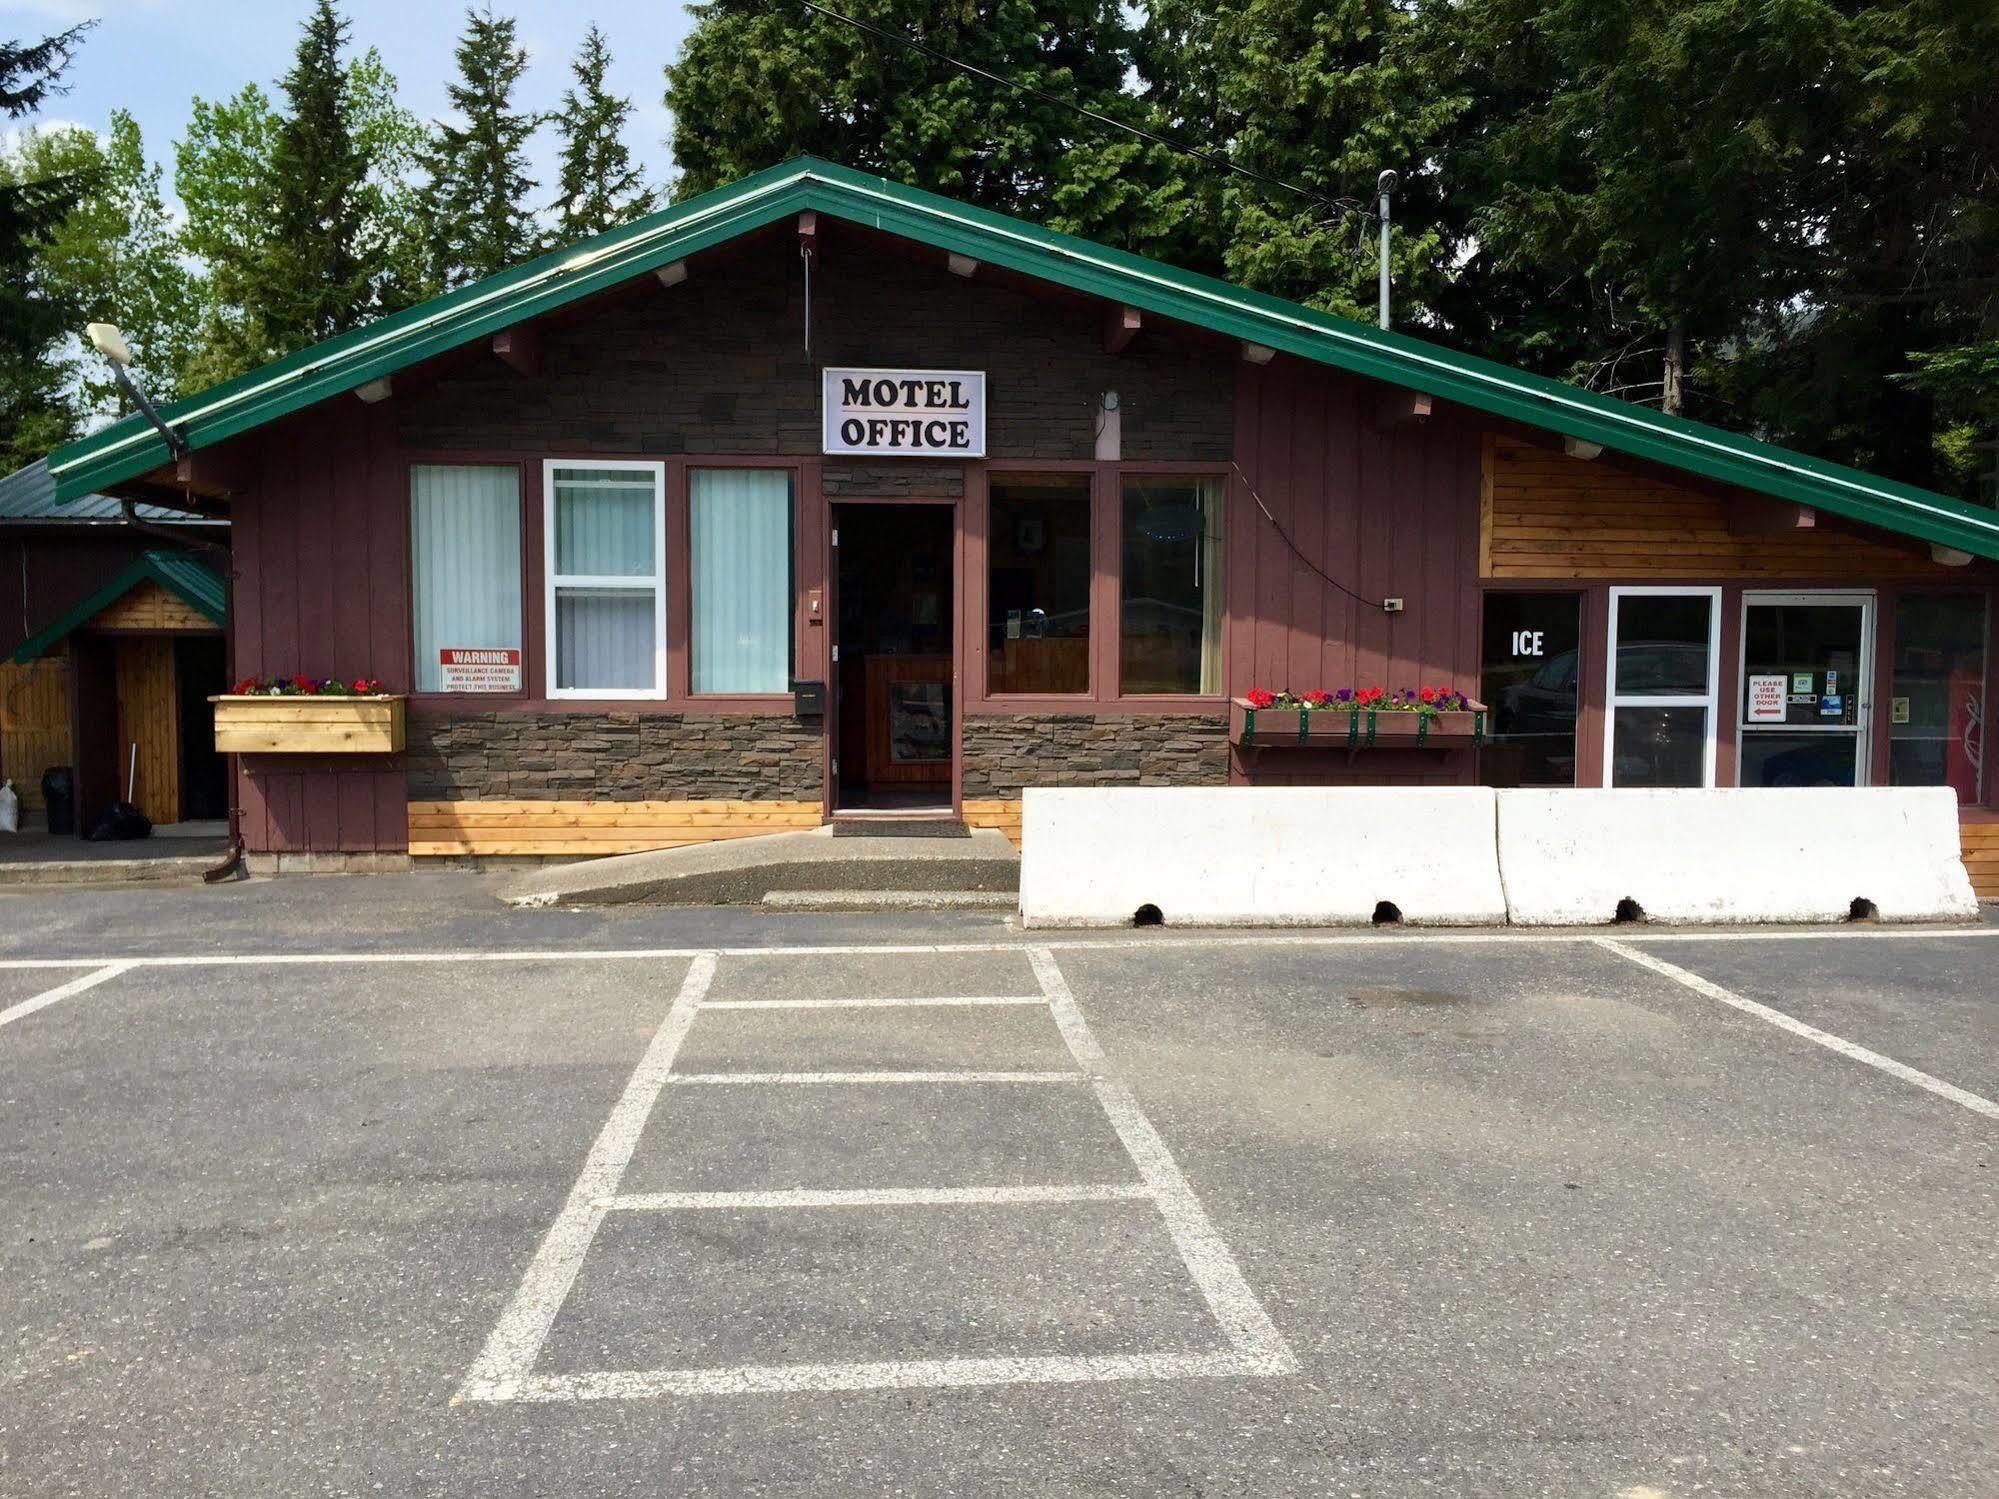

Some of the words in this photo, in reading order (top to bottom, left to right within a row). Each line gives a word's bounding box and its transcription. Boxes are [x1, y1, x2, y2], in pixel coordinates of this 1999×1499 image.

[842, 379, 969, 409] MOTEL
[841, 418, 969, 448] OFFICE
[1512, 630, 1544, 656] ICE
[452, 651, 509, 664] WARNING
